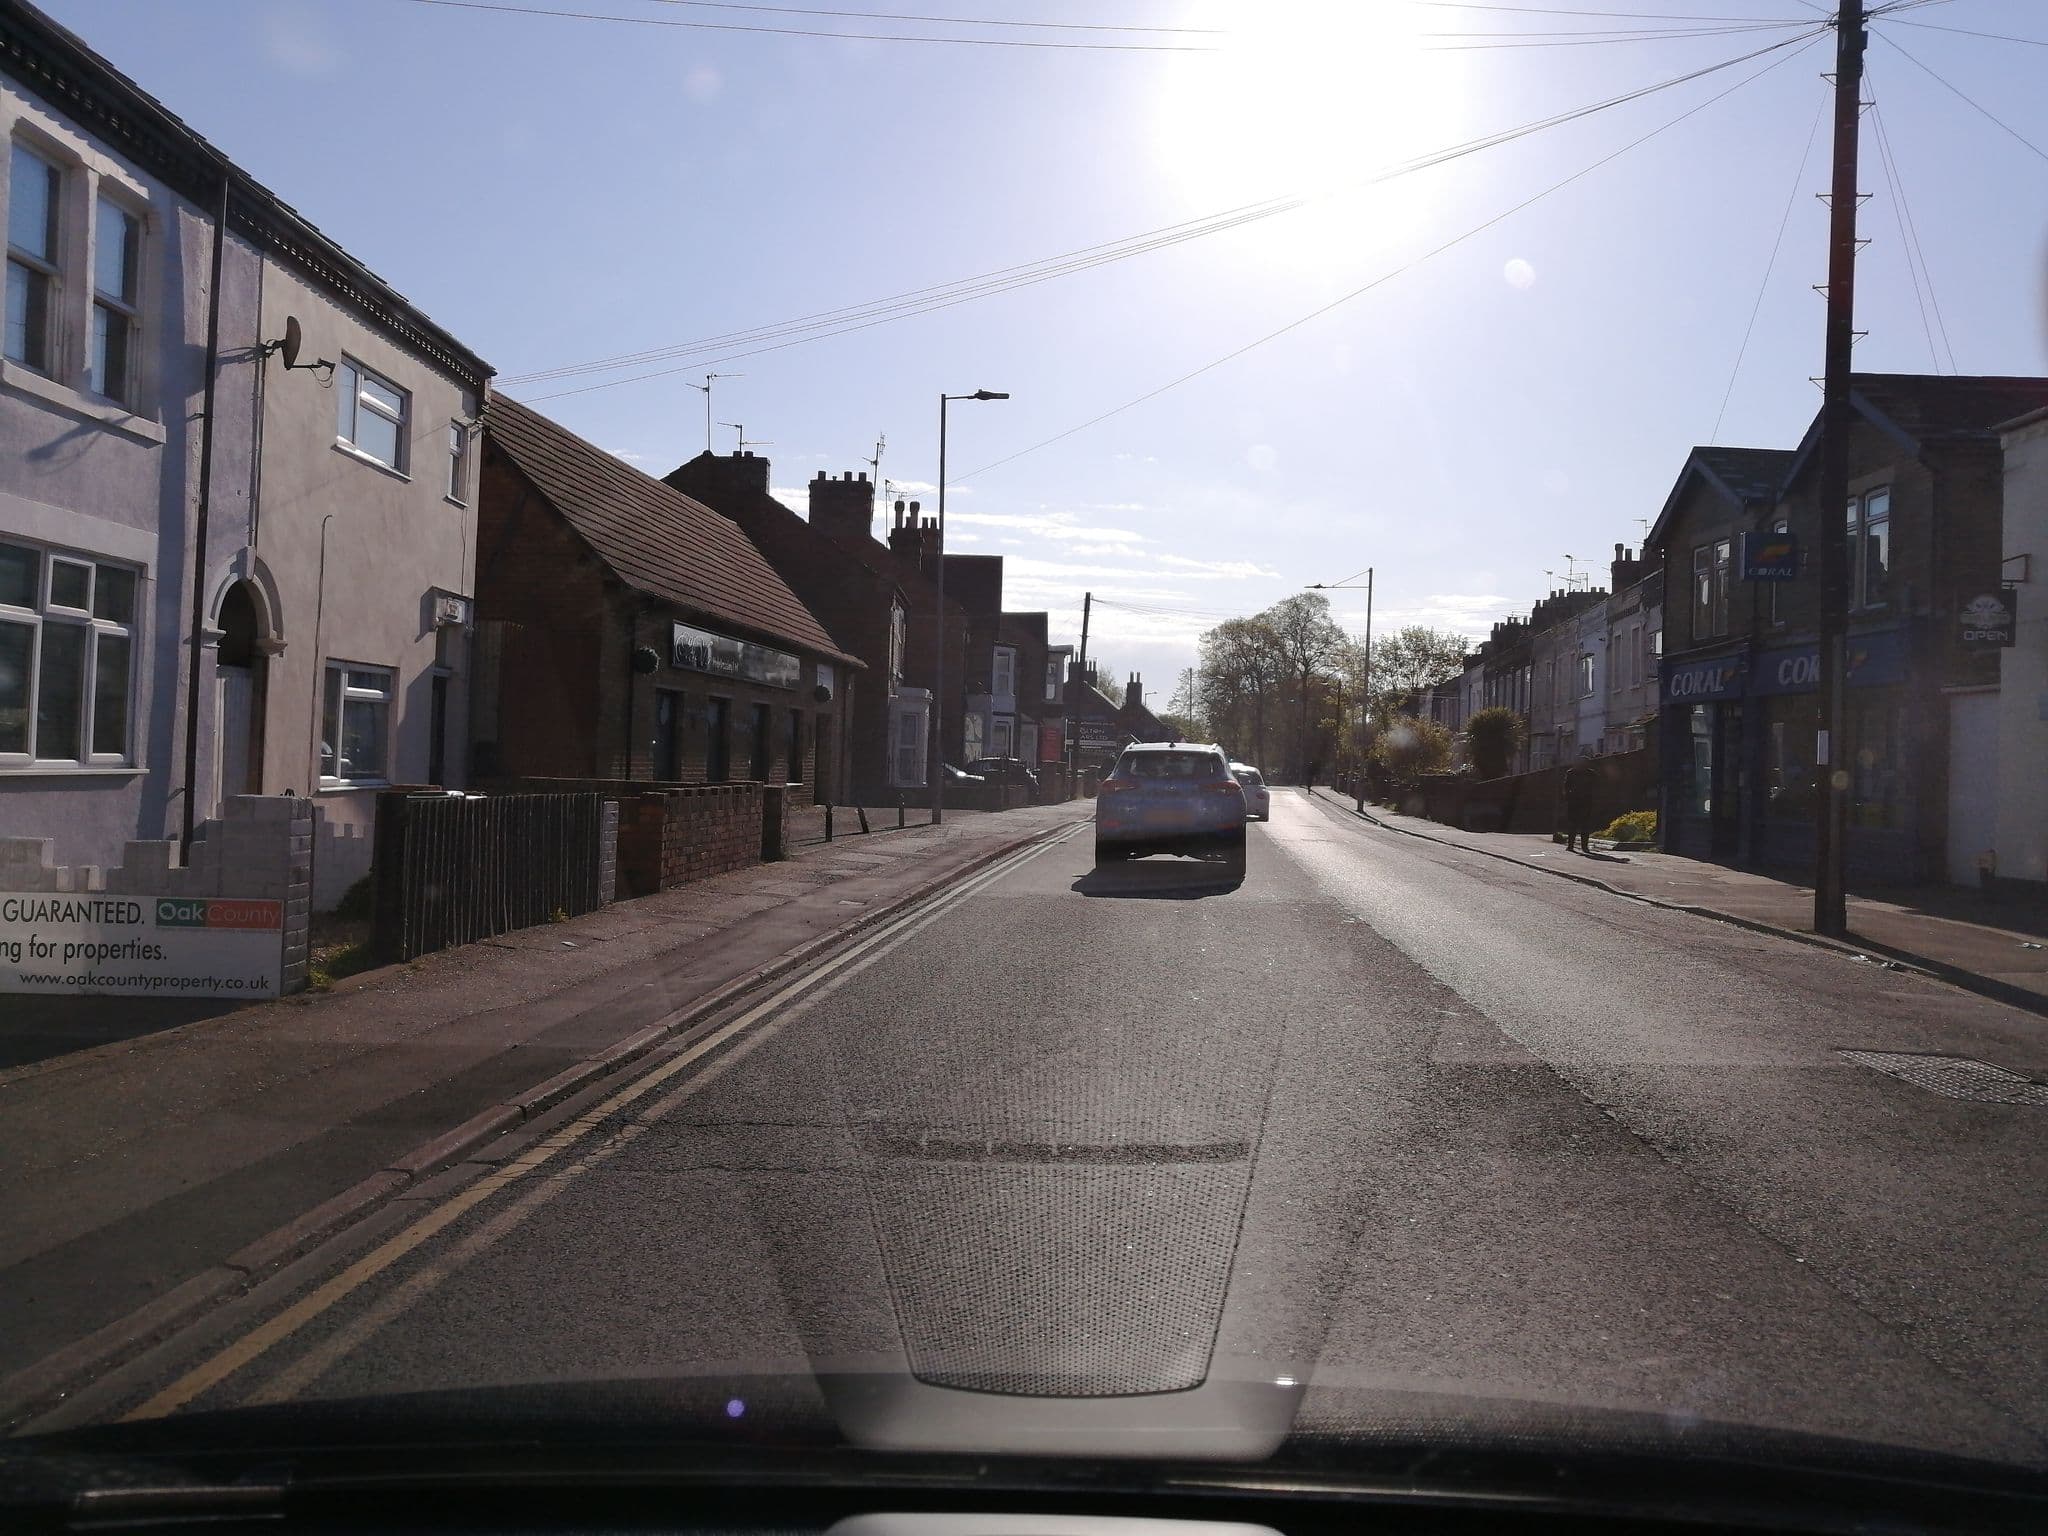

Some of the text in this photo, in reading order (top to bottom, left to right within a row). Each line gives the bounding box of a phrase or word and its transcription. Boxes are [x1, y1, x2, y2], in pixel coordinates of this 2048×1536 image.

[1748, 567, 1793, 577] CORAL
[1963, 630, 2009, 641] OPEN
[1670, 667, 1725, 697] CORAL
[2, 898, 146, 925] GUARANTEED.
[29, 933, 57, 958] for
[64, 937, 168, 965] properties.
[19, 971, 269, 993] www.oakcountyproperty.co.uk
